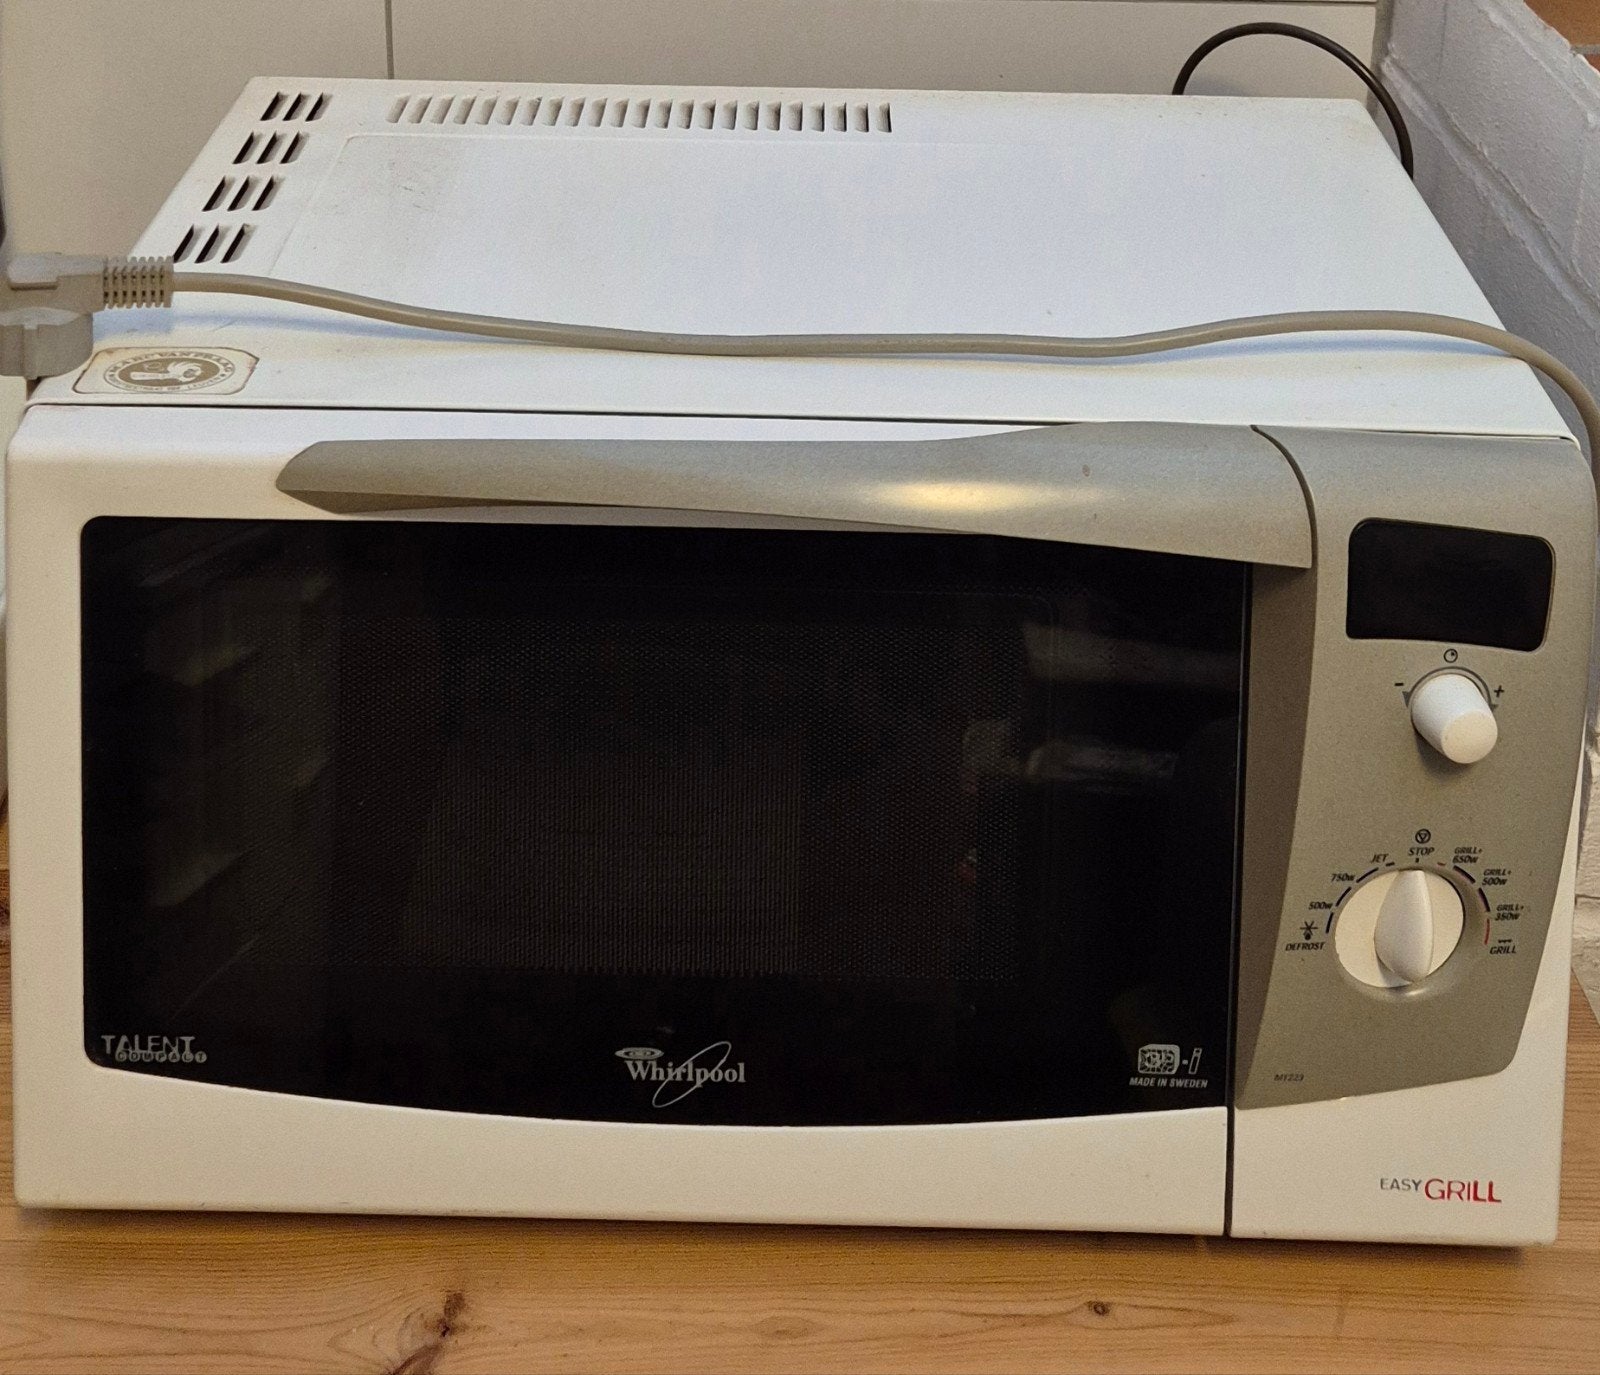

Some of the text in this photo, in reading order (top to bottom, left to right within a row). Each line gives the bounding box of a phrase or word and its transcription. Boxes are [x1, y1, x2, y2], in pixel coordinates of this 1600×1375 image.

[1408, 847, 1435, 856] STOP
[1370, 854, 1388, 863] JET
[1285, 942, 1325, 951] DEFROST
[1489, 945, 1517, 955] GRILL
[101, 1034, 195, 1055] TALENT
[625, 1060, 746, 1088] Whirlpool
[1129, 1077, 1208, 1089] MADE IN SWEDEN
[1380, 1178, 1502, 1203] EASY GRILL
